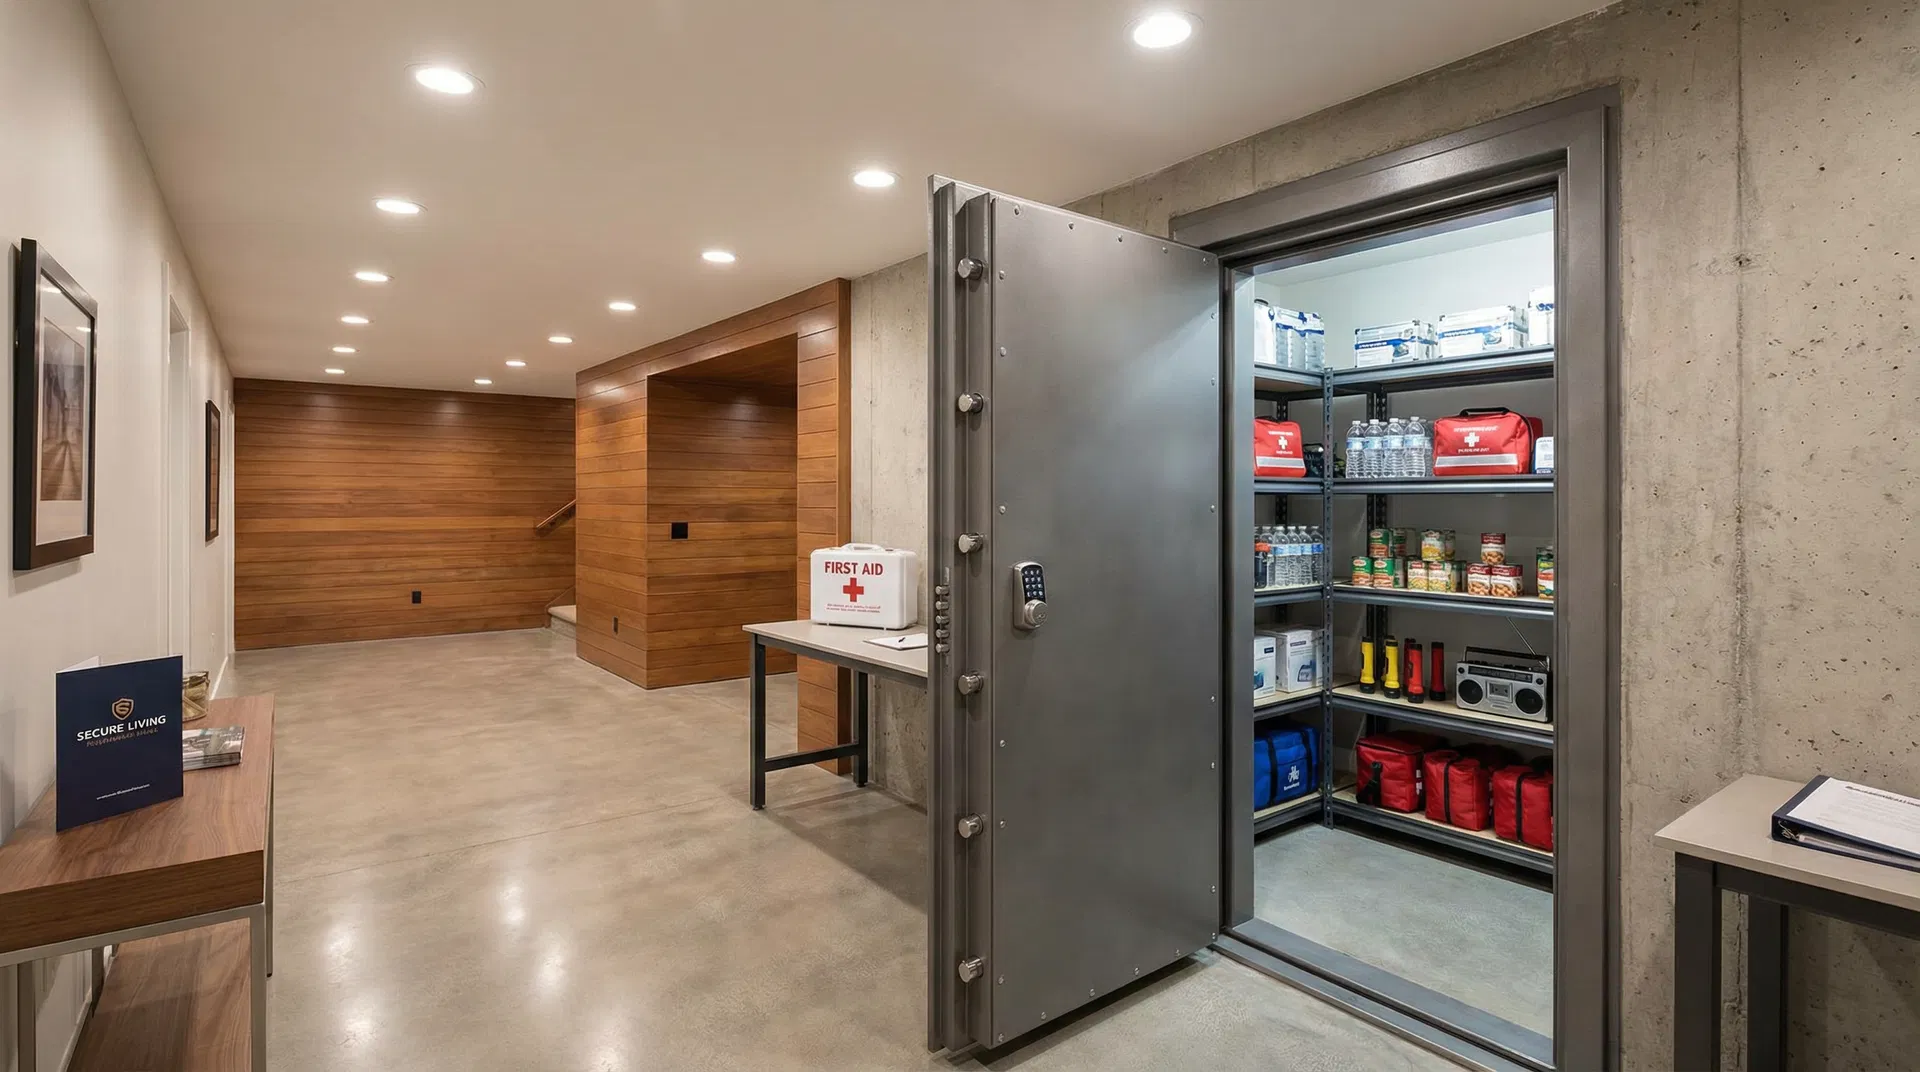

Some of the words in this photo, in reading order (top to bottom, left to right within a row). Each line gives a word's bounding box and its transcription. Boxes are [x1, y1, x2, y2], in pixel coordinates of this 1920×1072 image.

[825, 561, 858, 575] FIRST
[862, 563, 884, 576] AID
[77, 723, 124, 742] SECURE
[128, 715, 166, 731] LIVING
